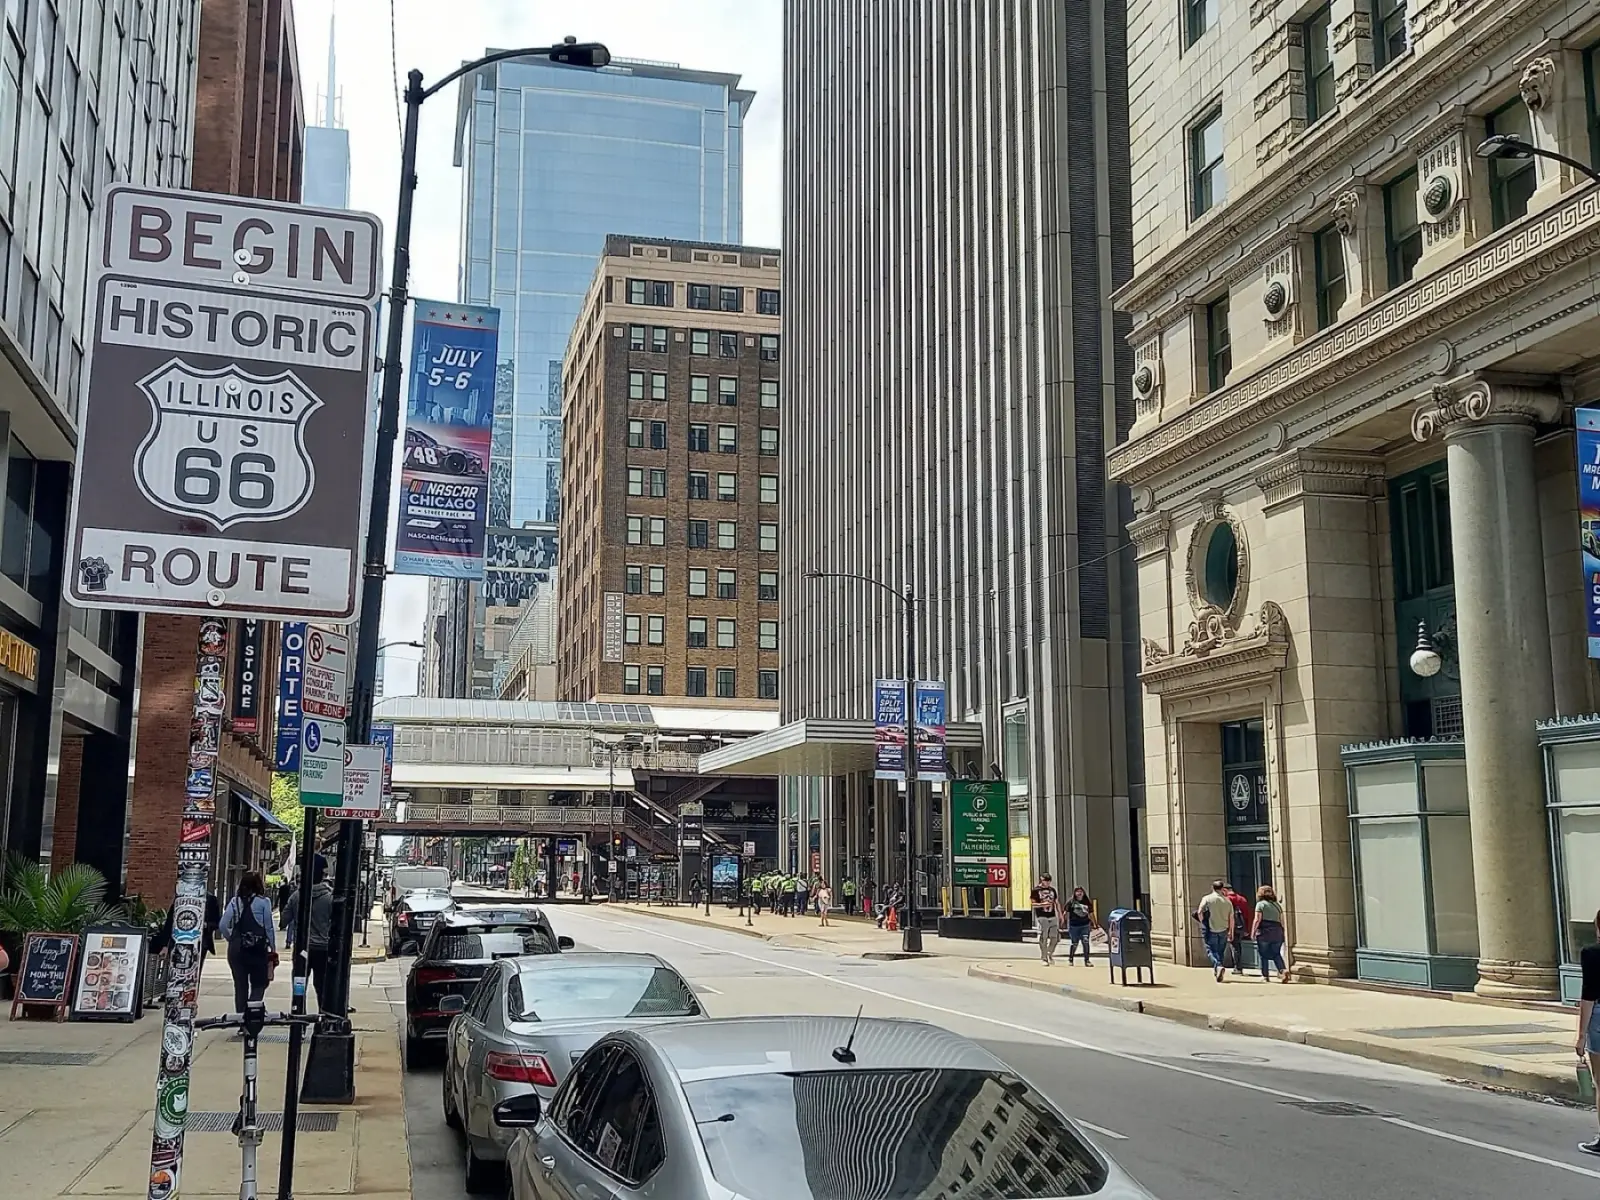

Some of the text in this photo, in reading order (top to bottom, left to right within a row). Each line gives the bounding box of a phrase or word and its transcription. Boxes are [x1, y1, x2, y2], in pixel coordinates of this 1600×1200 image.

[129, 205, 355, 285] BEGIN
[110, 296, 356, 357] HISTORIC
[432, 345, 482, 368] JULY
[428, 367, 472, 390] 5-6
[167, 381, 294, 415] ILLINOIS
[413, 446, 438, 465] 48
[174, 448, 275, 508] 66
[426, 482, 479, 498] NASCAR
[409, 494, 476, 509] CHICAGO
[407, 532, 473, 543] NASCARChicago.com
[121, 544, 310, 595] ROUTE
[241, 645, 254, 708] STORE
[306, 667, 335, 681] PHILIPPINES
[306, 677, 333, 691] CONSULATE
[305, 687, 339, 702] PARKING ONLY
[923, 697, 939, 705] JULY
[305, 700, 343, 718] TOW ZONE
[880, 699, 903, 707] SPLIT-
[879, 713, 901, 722] CITY
[303, 759, 327, 769] RESERVED
[303, 770, 323, 779] PARKING
[330, 808, 348, 816] TOW
[30, 971, 64, 979] MON-THU
